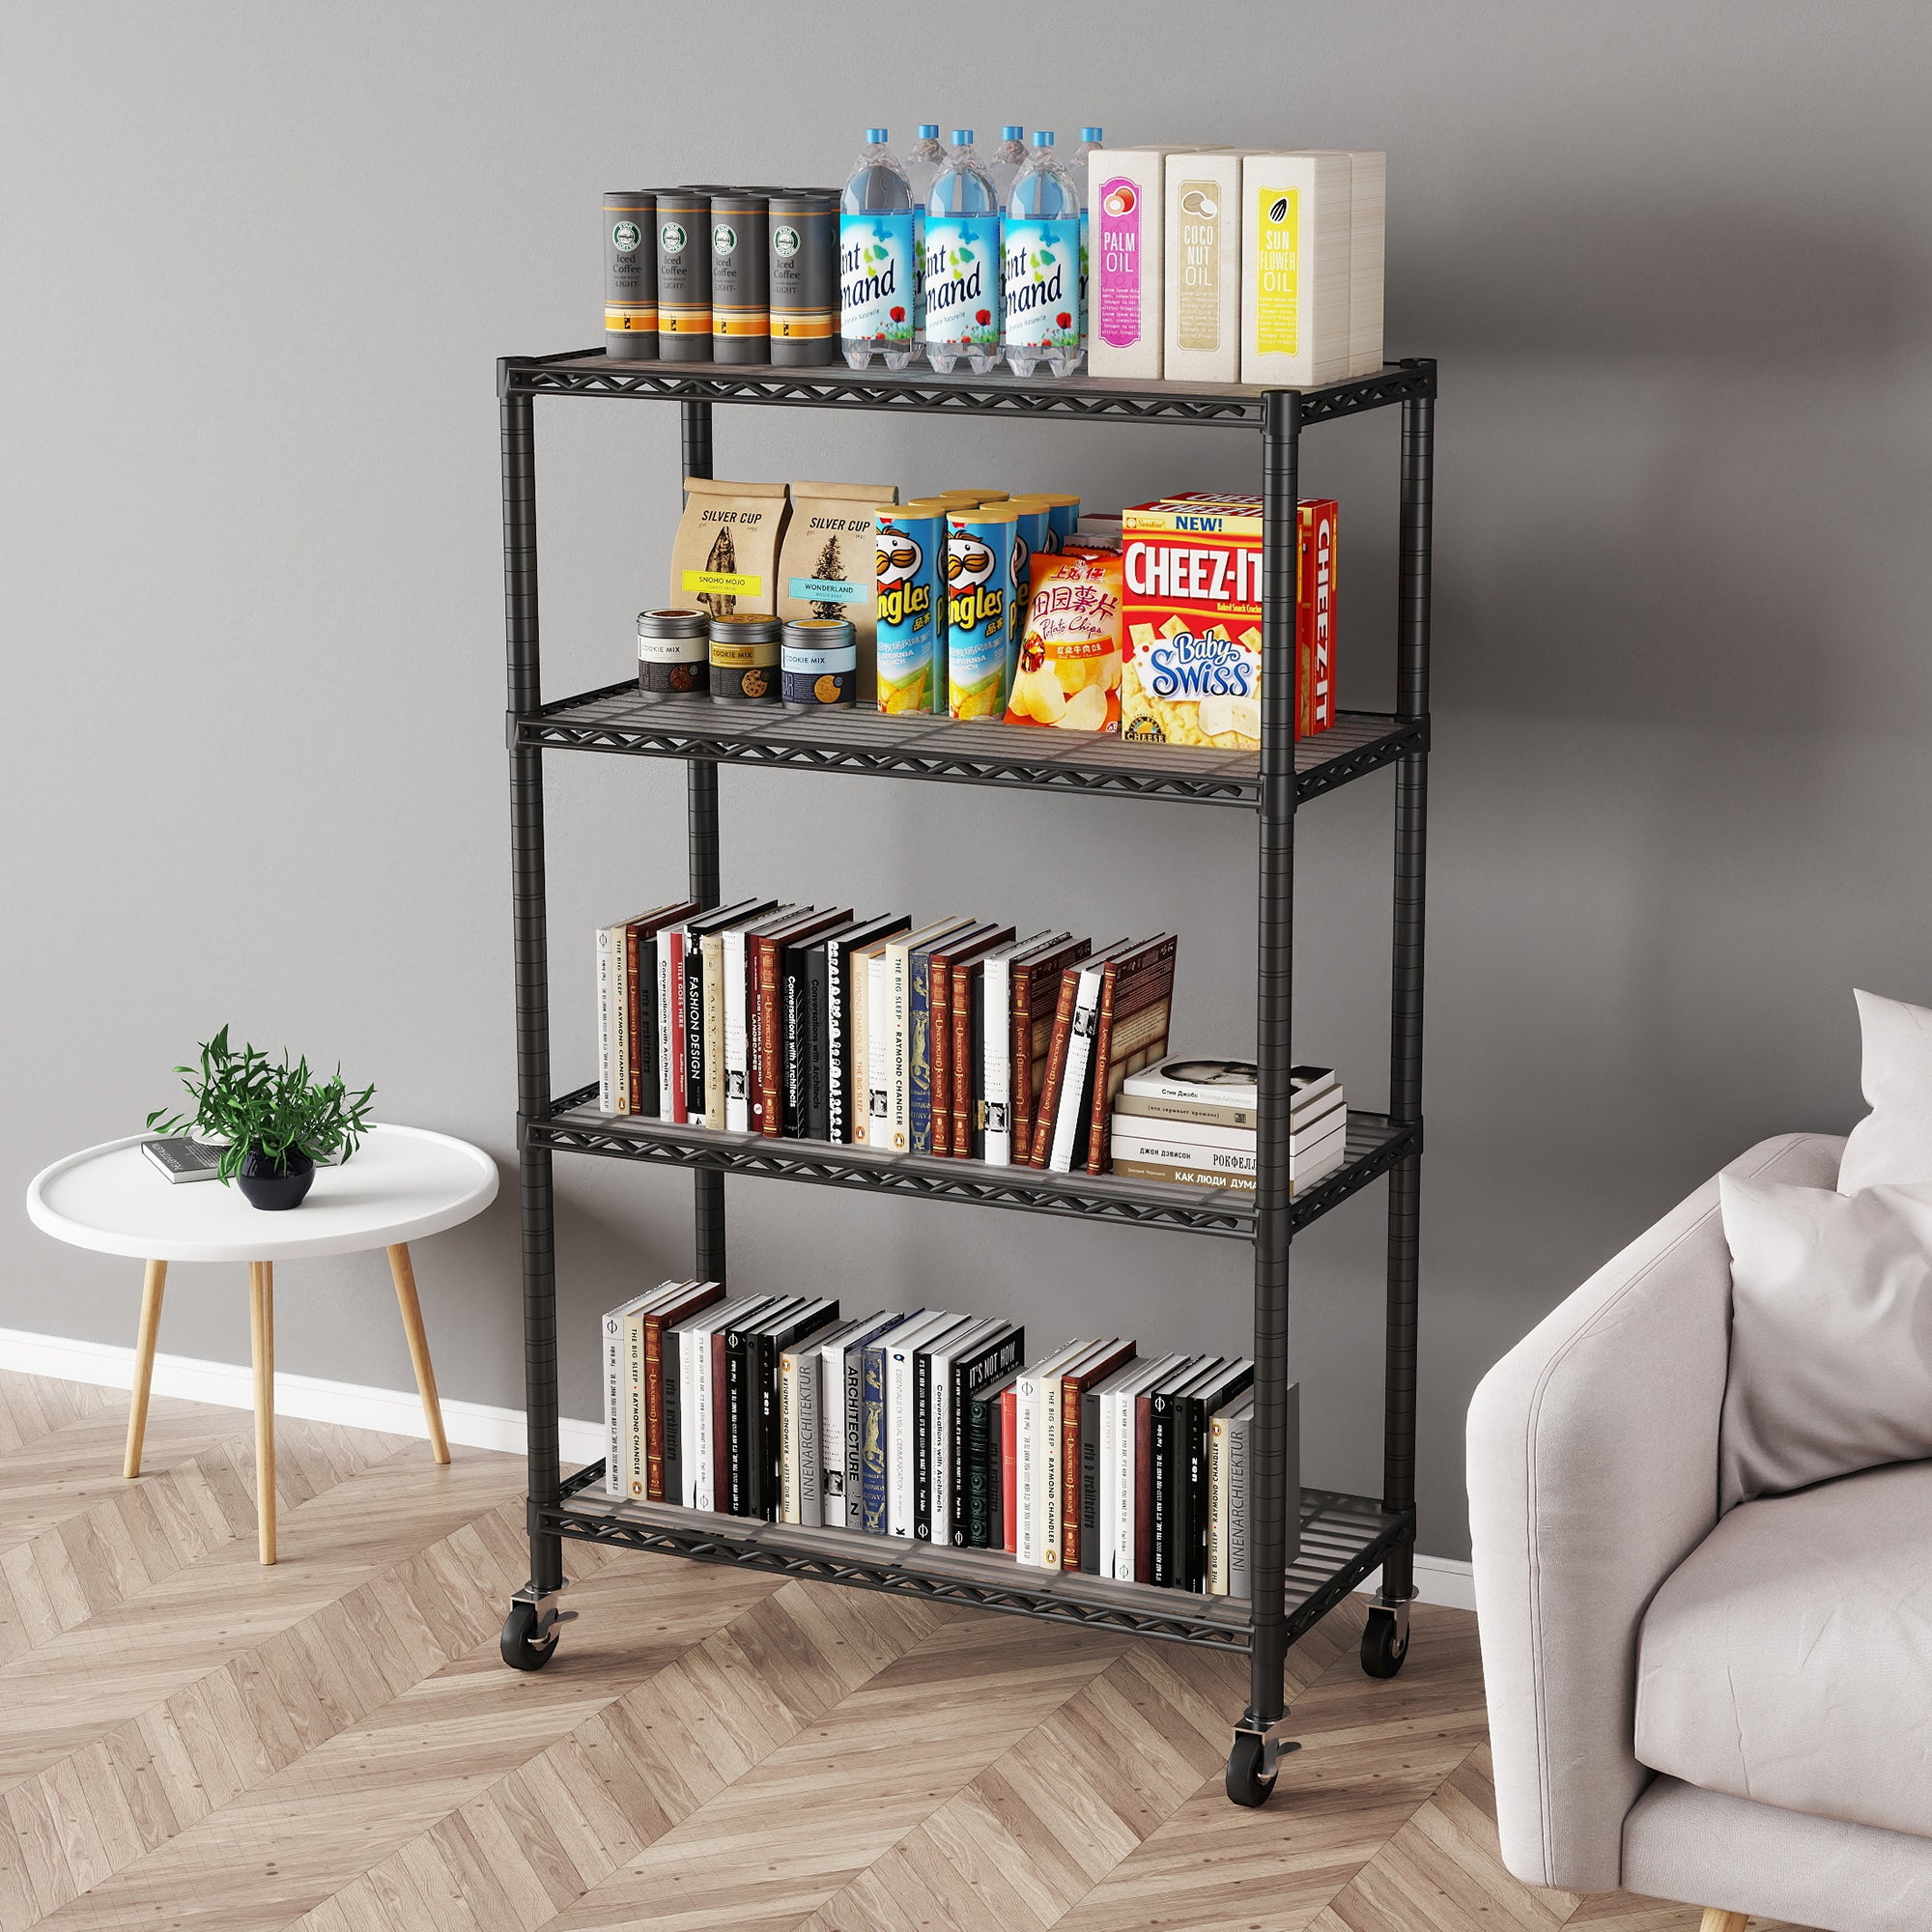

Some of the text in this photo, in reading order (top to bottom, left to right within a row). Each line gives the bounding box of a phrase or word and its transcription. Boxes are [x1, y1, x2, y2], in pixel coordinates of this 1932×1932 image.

[1104, 232, 1134, 251] PALM
[1184, 225, 1212, 244] COCO
[1266, 231, 1289, 249] SUN
[616, 255, 635, 264] Iced
[665, 256, 681, 265] Iced
[716, 258, 731, 267] Iced
[777, 260, 794, 269] Iced
[1107, 253, 1133, 272] OIL
[1187, 246, 1209, 265] NUT
[1260, 252, 1294, 270] FLOWER
[612, 265, 641, 273] Coffee
[661, 266, 687, 275] Coffee
[713, 268, 737, 277] Coffee
[774, 270, 800, 279] Coffee
[1186, 267, 1211, 286] OIL
[1264, 272, 1291, 292] OIL
[701, 510, 761, 524] SILVER CUP
[810, 518, 870, 532] SILVER CUP
[1176, 516, 1223, 531] NEW!
[805, 583, 853, 593] WONDERLAND
[1033, 585, 1120, 622] 田园薯片
[1040, 618, 1065, 639] Potato
[1316, 519, 1331, 726] CHEEZ-IT
[1173, 630, 1240, 666] Baby
[1127, 733, 1165, 742] CHEESE
[811, 980, 820, 1042] Conversations
[689, 977, 700, 1080] FASHION DESIGN
[788, 1064, 797, 1108] Architects
[1161, 1151, 1191, 1159] ДЭВИСОН
[1175, 1172, 1194, 1181] КАК
[1197, 1175, 1227, 1186] ЛЮДИ
[970, 1341, 1015, 1388] IT'S NOT HOW
[848, 1366, 859, 1481] ARCHITECTURE
[799, 1366, 815, 1501] INNENARCHITEKTUR
[1231, 1432, 1244, 1572] INNENARCHITEKTUR
